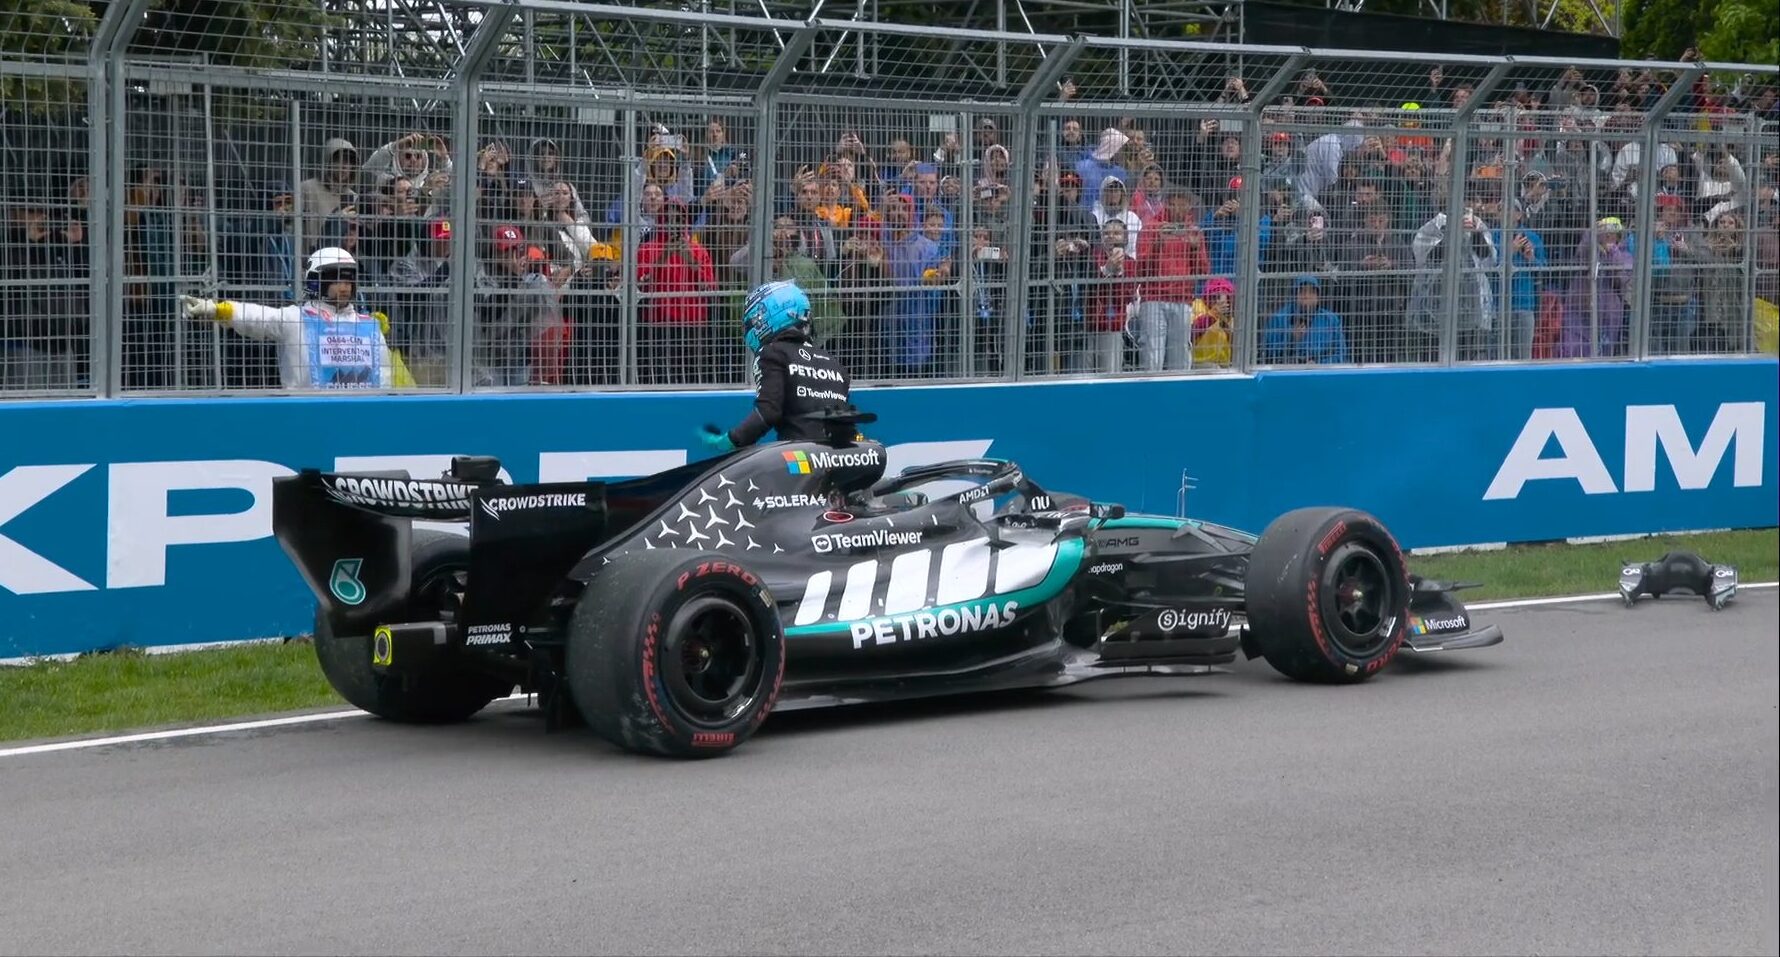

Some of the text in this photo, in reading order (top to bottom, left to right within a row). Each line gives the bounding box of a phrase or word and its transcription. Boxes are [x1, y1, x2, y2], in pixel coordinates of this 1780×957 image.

[811, 450, 880, 469] Microsoft
[489, 493, 587, 512] CROWDSTRIKE
[764, 495, 819, 510] SOLERA
[832, 530, 923, 548] TeamViewer
[1106, 536, 1140, 548] AMG
[696, 561, 758, 586] ZERO
[468, 623, 512, 634] PETRONAS
[850, 601, 1019, 649] PETRONAS
[1424, 615, 1467, 630] Microsoft
[466, 632, 513, 646] PRIMAX
